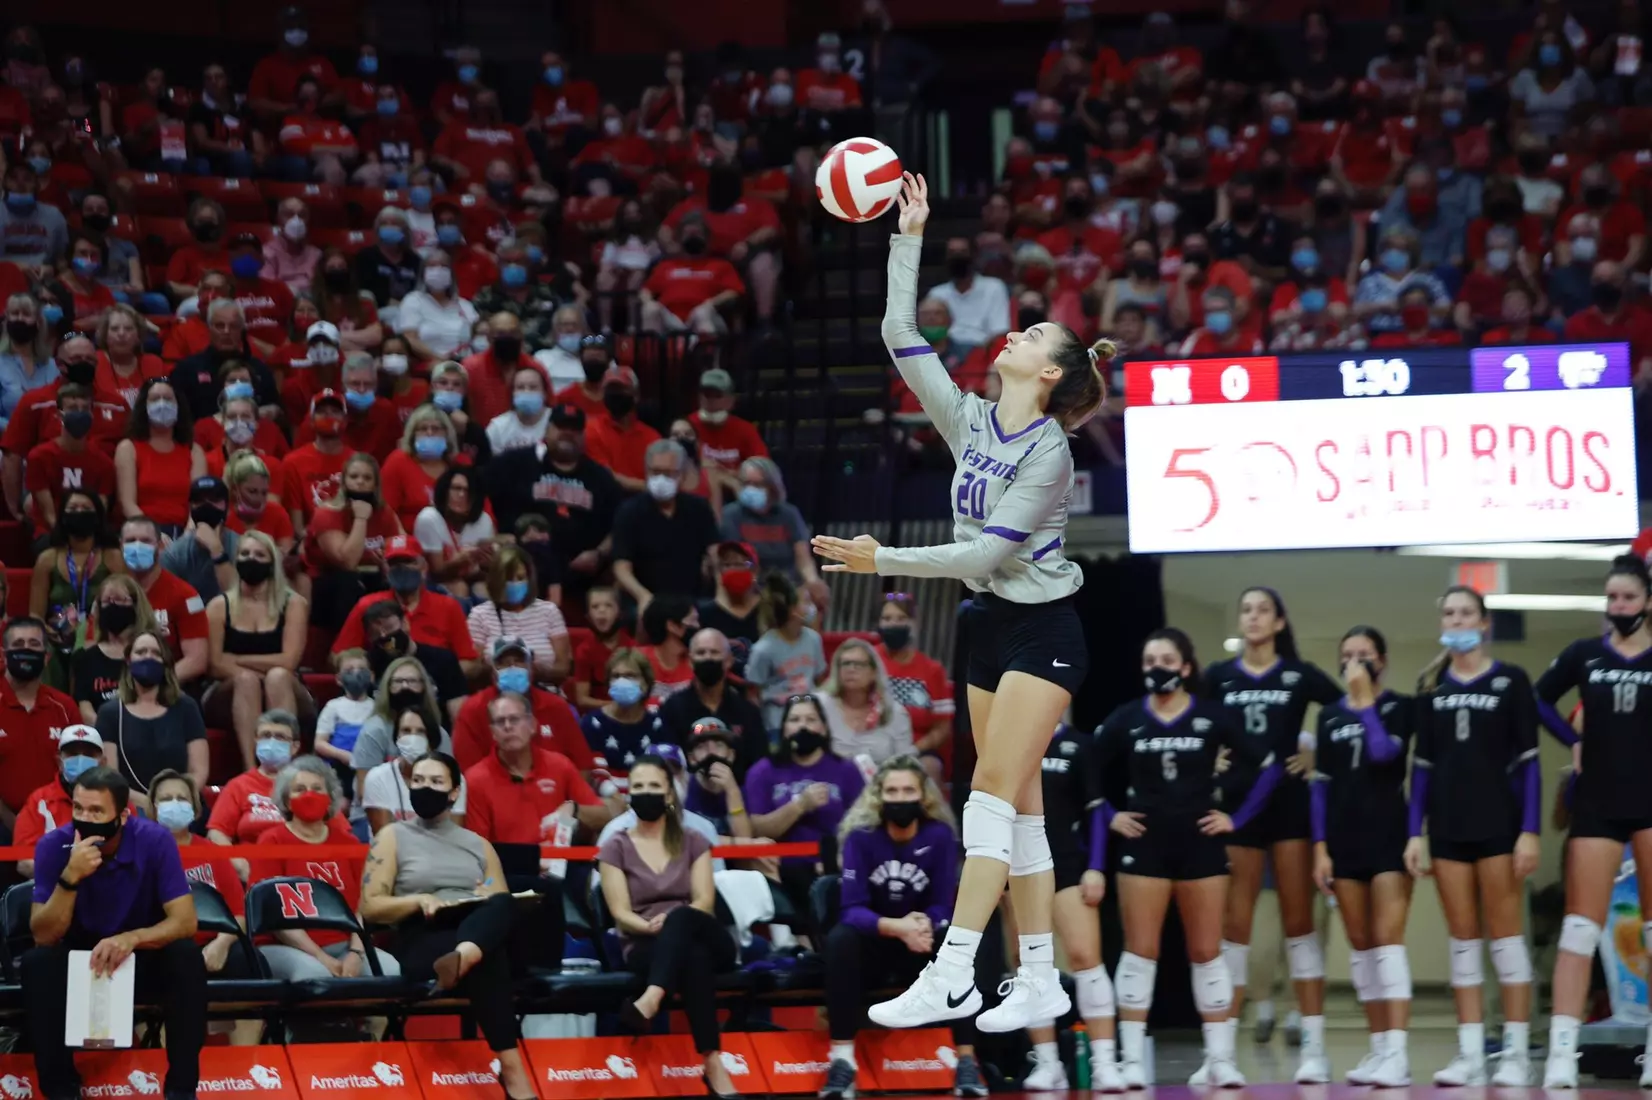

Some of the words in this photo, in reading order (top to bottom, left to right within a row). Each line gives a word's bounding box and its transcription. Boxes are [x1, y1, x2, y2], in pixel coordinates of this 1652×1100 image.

[1502, 353, 1530, 390] 2
[1221, 364, 1249, 402] 0
[63, 467, 83, 488] N
[957, 471, 988, 521] 20
[1224, 690, 1293, 706] K-STATE
[1433, 693, 1500, 711] K-STATE
[1612, 683, 1638, 713] 18
[1243, 703, 1268, 734] 15
[1134, 737, 1206, 752] K-STATE
[1349, 737, 1363, 769] 7
[307, 861, 345, 890] N
[275, 882, 319, 918] N
[547, 1067, 613, 1081] Ameritas
[883, 1058, 942, 1072] Ameritas
[196, 1077, 253, 1092] meritas
[310, 1074, 378, 1089] Ameritas
[432, 1070, 495, 1085] Ameritas
[80, 1083, 132, 1098] meritas
